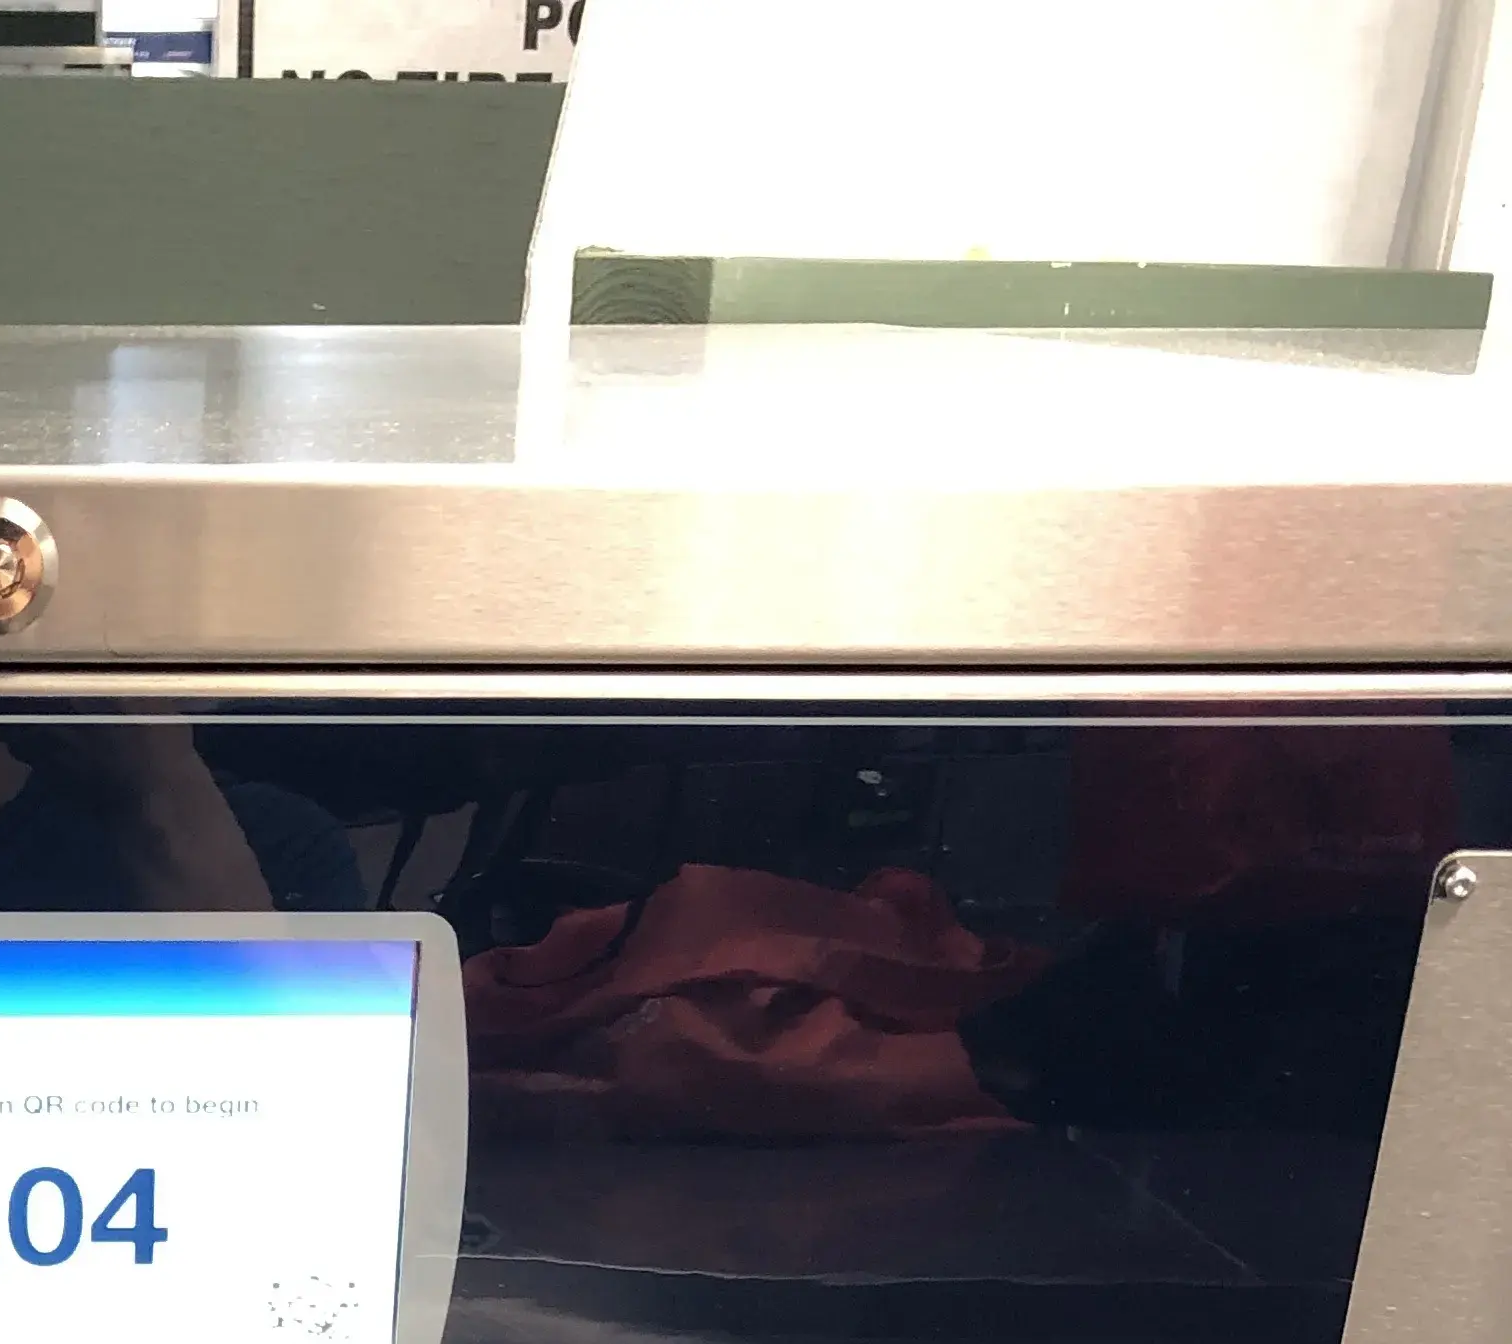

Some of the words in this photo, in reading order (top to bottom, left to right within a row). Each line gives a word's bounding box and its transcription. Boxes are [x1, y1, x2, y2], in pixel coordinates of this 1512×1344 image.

[24, 1095, 64, 1114] QR
[75, 1096, 139, 1114] code
[151, 1097, 176, 1114] to
[186, 1095, 260, 1118] begin
